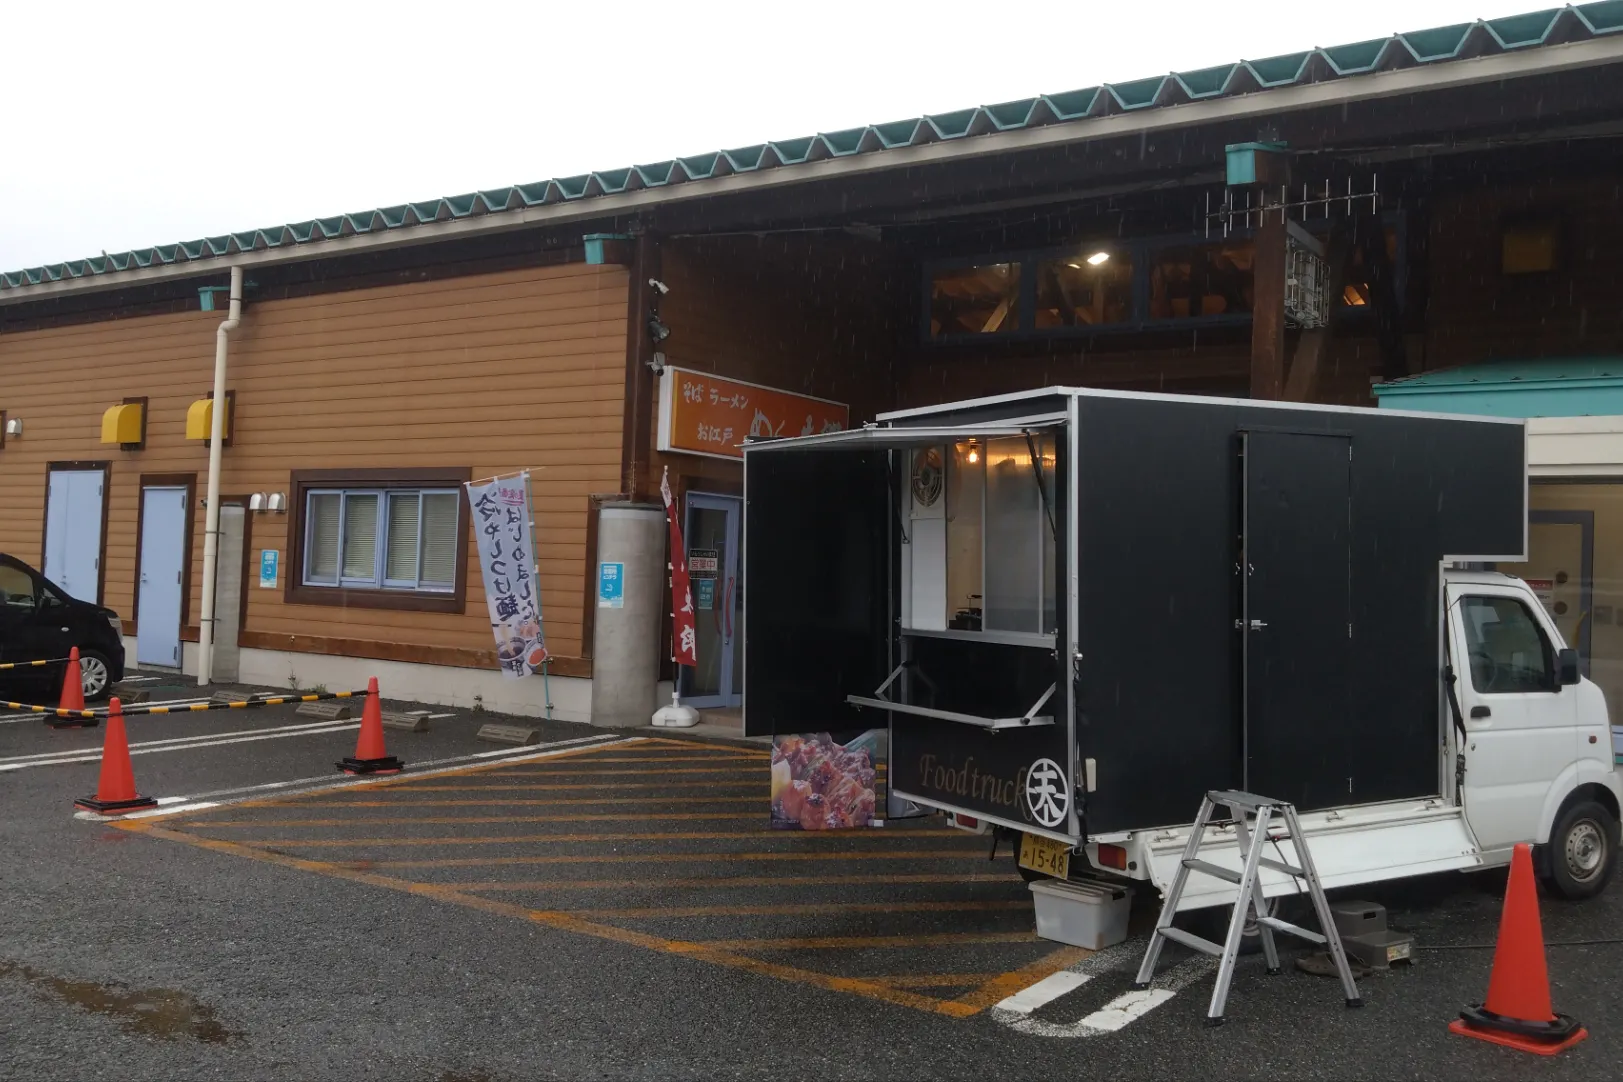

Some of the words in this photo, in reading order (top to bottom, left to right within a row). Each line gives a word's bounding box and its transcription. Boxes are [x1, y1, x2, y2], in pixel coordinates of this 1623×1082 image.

[683, 383, 704, 403] そば
[710, 388, 749, 410] ラーメン
[697, 422, 734, 446] お江戸
[691, 558, 716, 570] 営業中
[1031, 847, 1065, 875] 15-48
